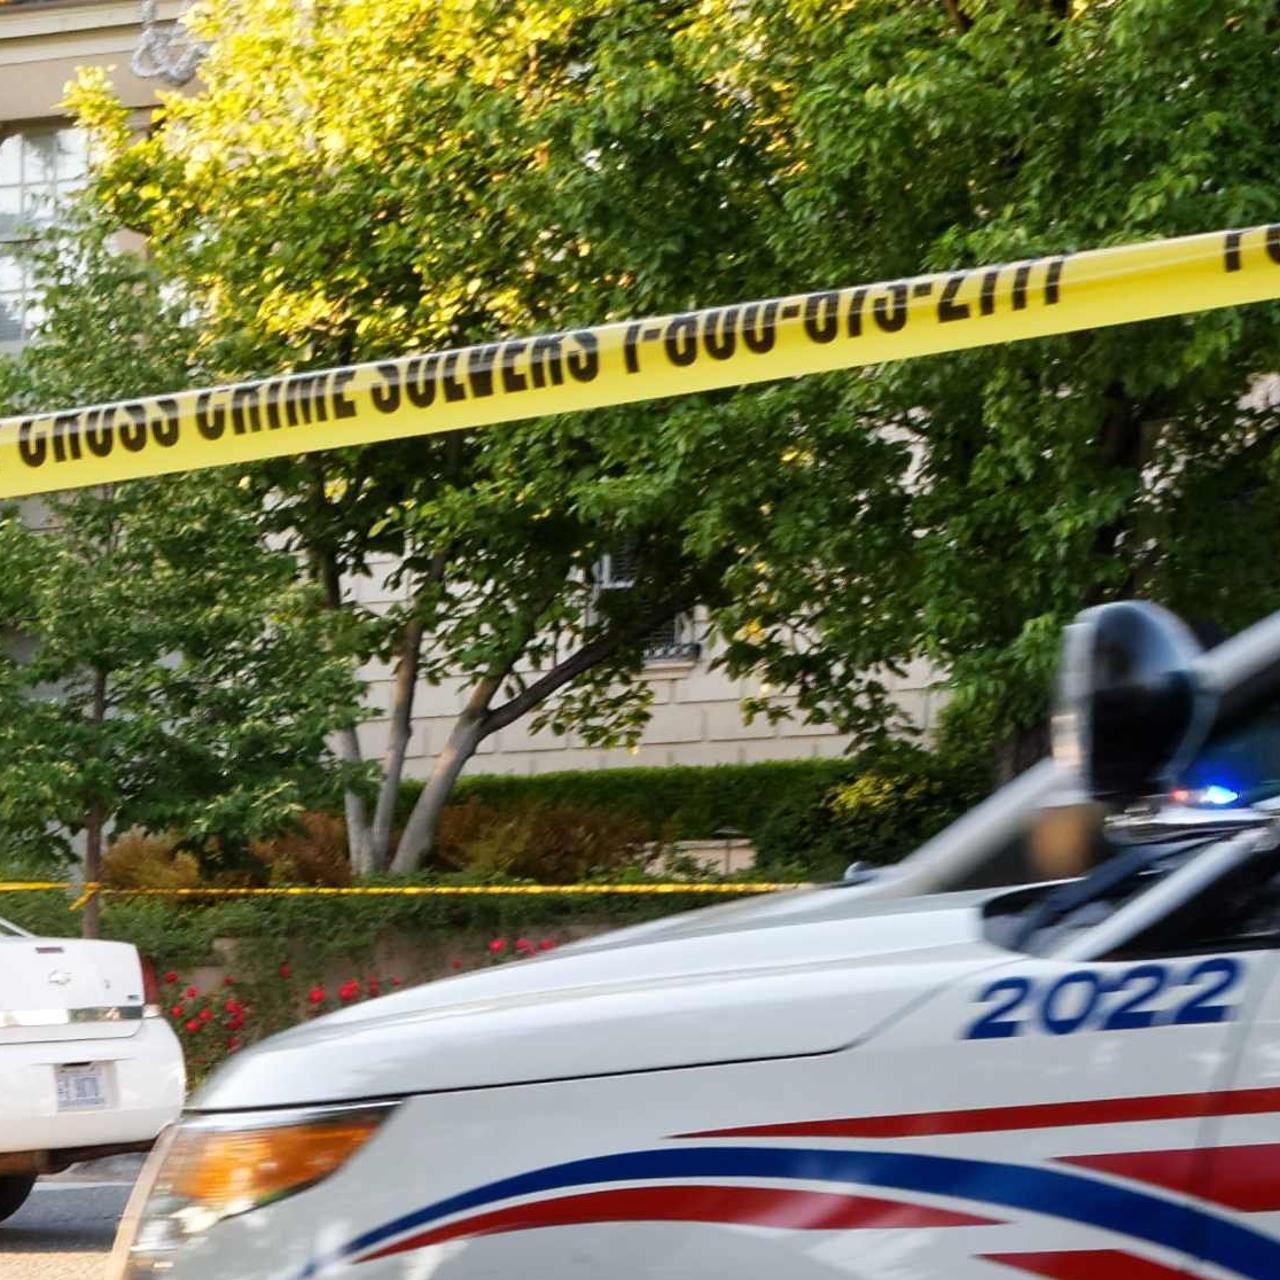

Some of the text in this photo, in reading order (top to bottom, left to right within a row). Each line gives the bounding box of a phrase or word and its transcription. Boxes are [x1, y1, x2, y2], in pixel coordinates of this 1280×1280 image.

[19, 398, 180, 467] CROSS
[196, 368, 357, 440] CRIME
[371, 330, 599, 413] SOLVERS
[962, 957, 1241, 1040] 2022
